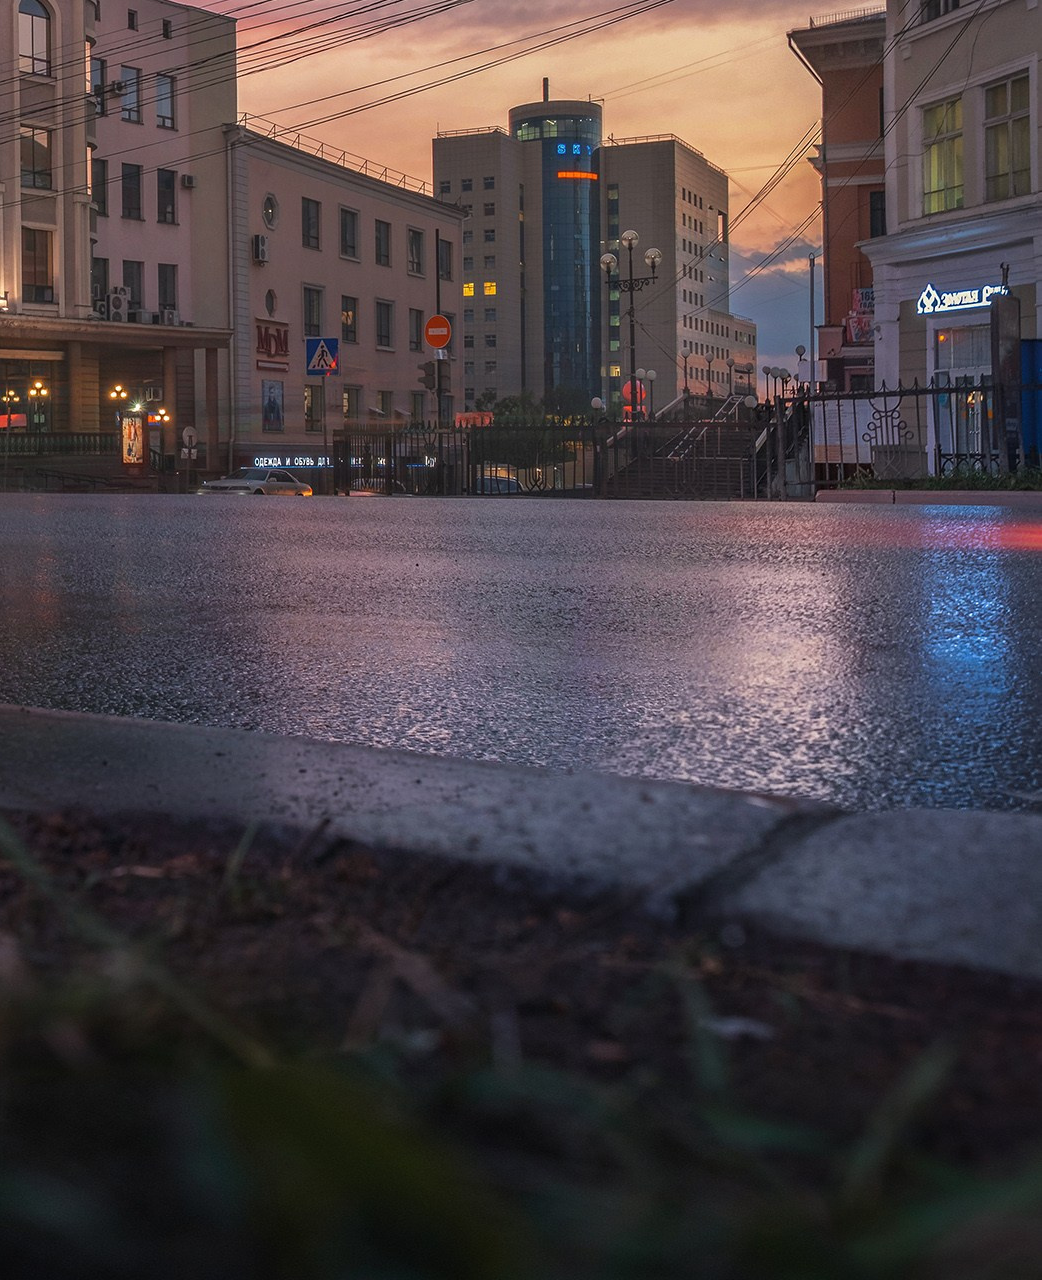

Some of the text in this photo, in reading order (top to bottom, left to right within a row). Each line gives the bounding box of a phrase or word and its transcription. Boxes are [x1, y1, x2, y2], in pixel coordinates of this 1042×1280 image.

[254, 457, 282, 467] ОДЕЖДА
[285, 457, 291, 466] И
[294, 457, 315, 466] ОБУВЬ
